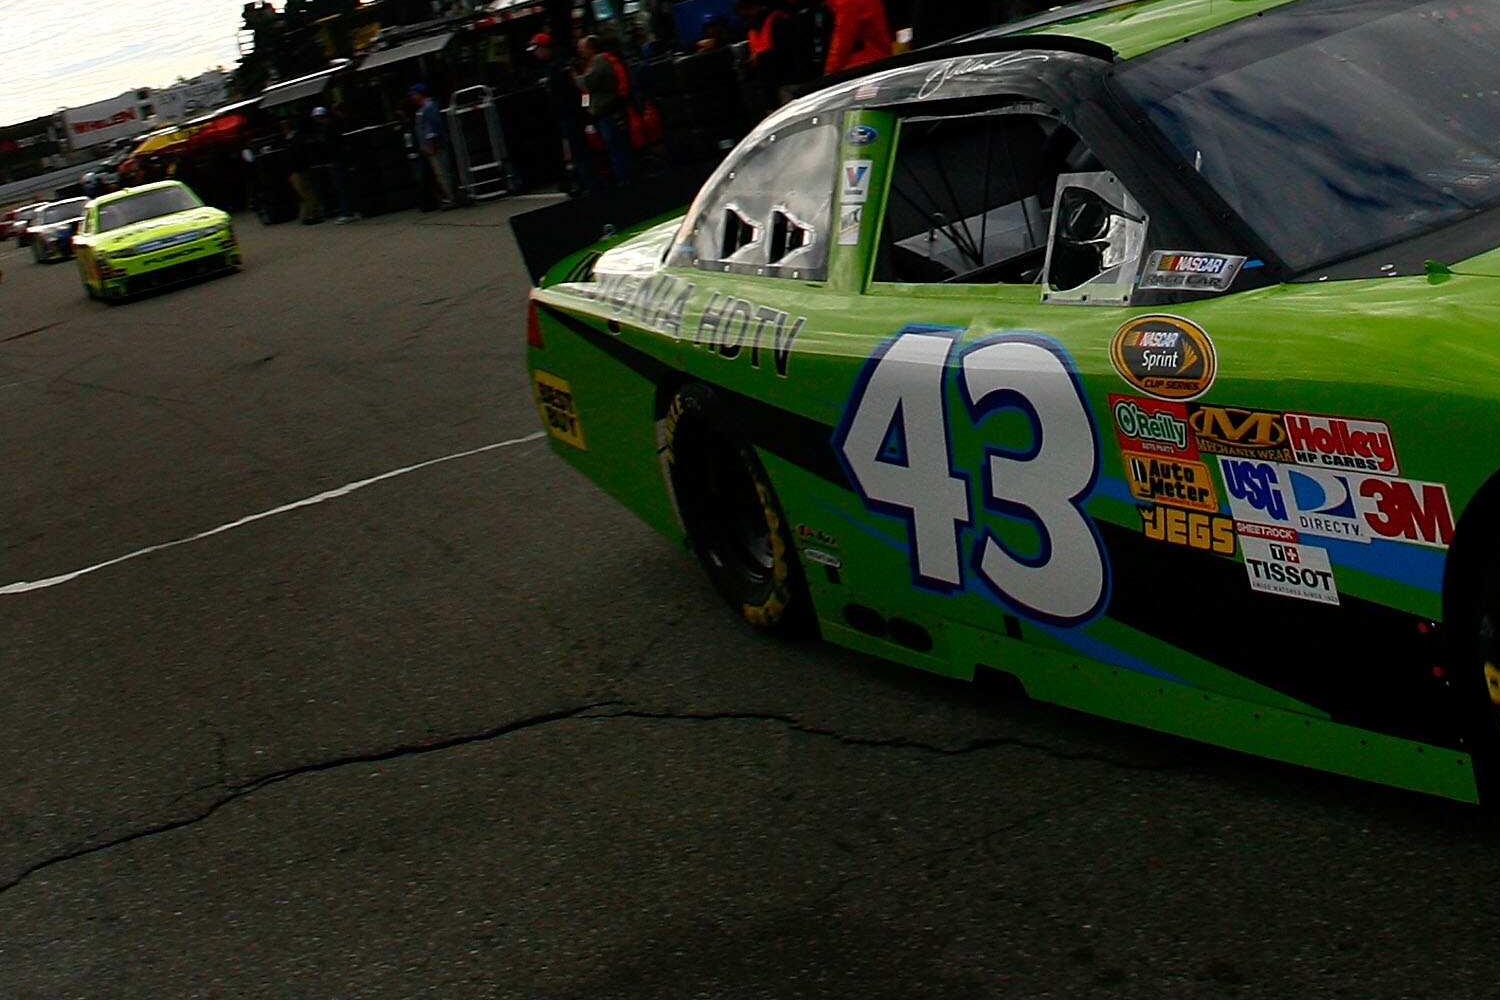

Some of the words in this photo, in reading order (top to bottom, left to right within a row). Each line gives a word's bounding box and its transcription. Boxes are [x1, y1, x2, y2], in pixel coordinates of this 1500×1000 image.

[1174, 255, 1226, 275] NASCAR
[694, 291, 808, 379] HDTV
[1138, 331, 1181, 348] NASCAR
[1141, 349, 1179, 371] Sprint
[1143, 380, 1165, 389] CUP
[1165, 381, 1200, 391] SERIES
[1115, 400, 1188, 449] O'Reilly
[1195, 437, 1256, 458] MECHANIX
[1257, 448, 1294, 463] WEAR
[1285, 415, 1395, 472] Holley
[835, 327, 1108, 623] 43
[1150, 460, 1195, 482] Auto
[1321, 454, 1378, 471] CARBS
[1150, 477, 1210, 502] Meter
[1220, 458, 1289, 521] USG
[1359, 478, 1455, 546] 3M
[1144, 506, 1235, 554] JEGS
[1236, 522, 1296, 540] SHEETROCK
[1246, 558, 1333, 591] TISSOT
